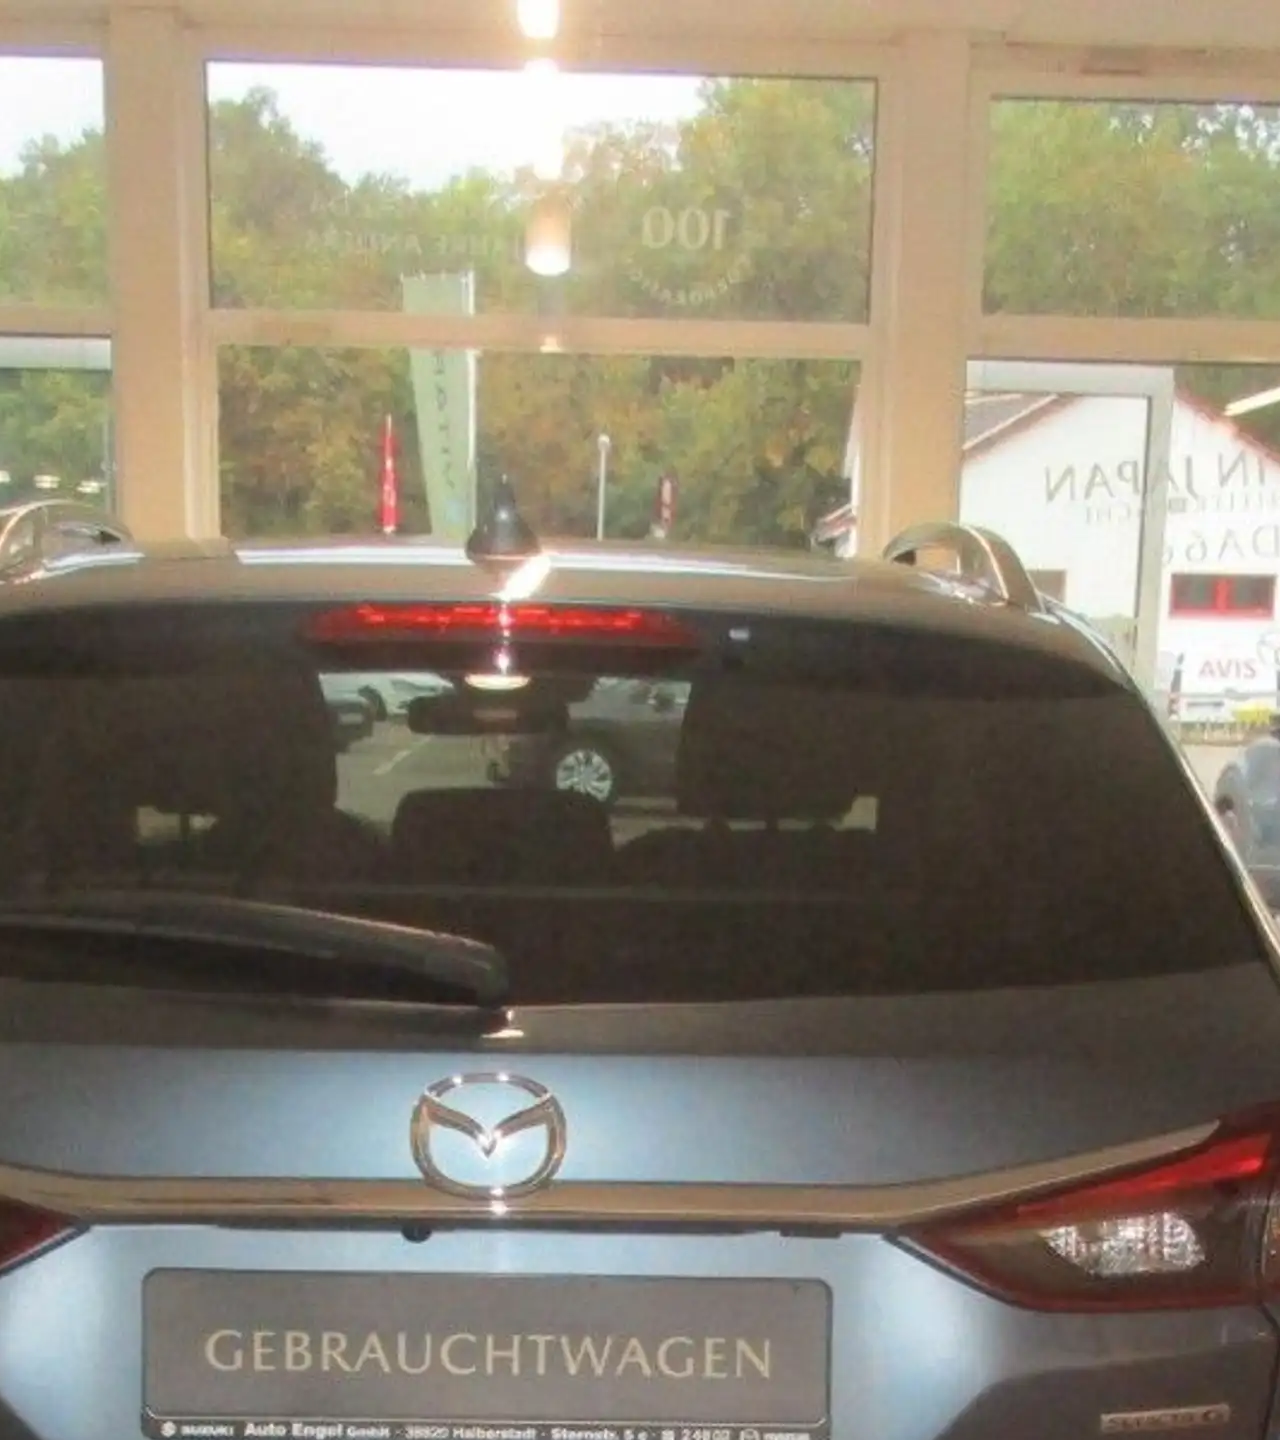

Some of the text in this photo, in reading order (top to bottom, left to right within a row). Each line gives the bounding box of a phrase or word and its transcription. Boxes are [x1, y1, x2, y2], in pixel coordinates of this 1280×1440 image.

[1200, 657, 1257, 680] AVIS
[205, 1328, 772, 1380] GEBRAUCHTWAGEN
[243, 1421, 287, 1438] Auto
[291, 1421, 344, 1440] Engel
